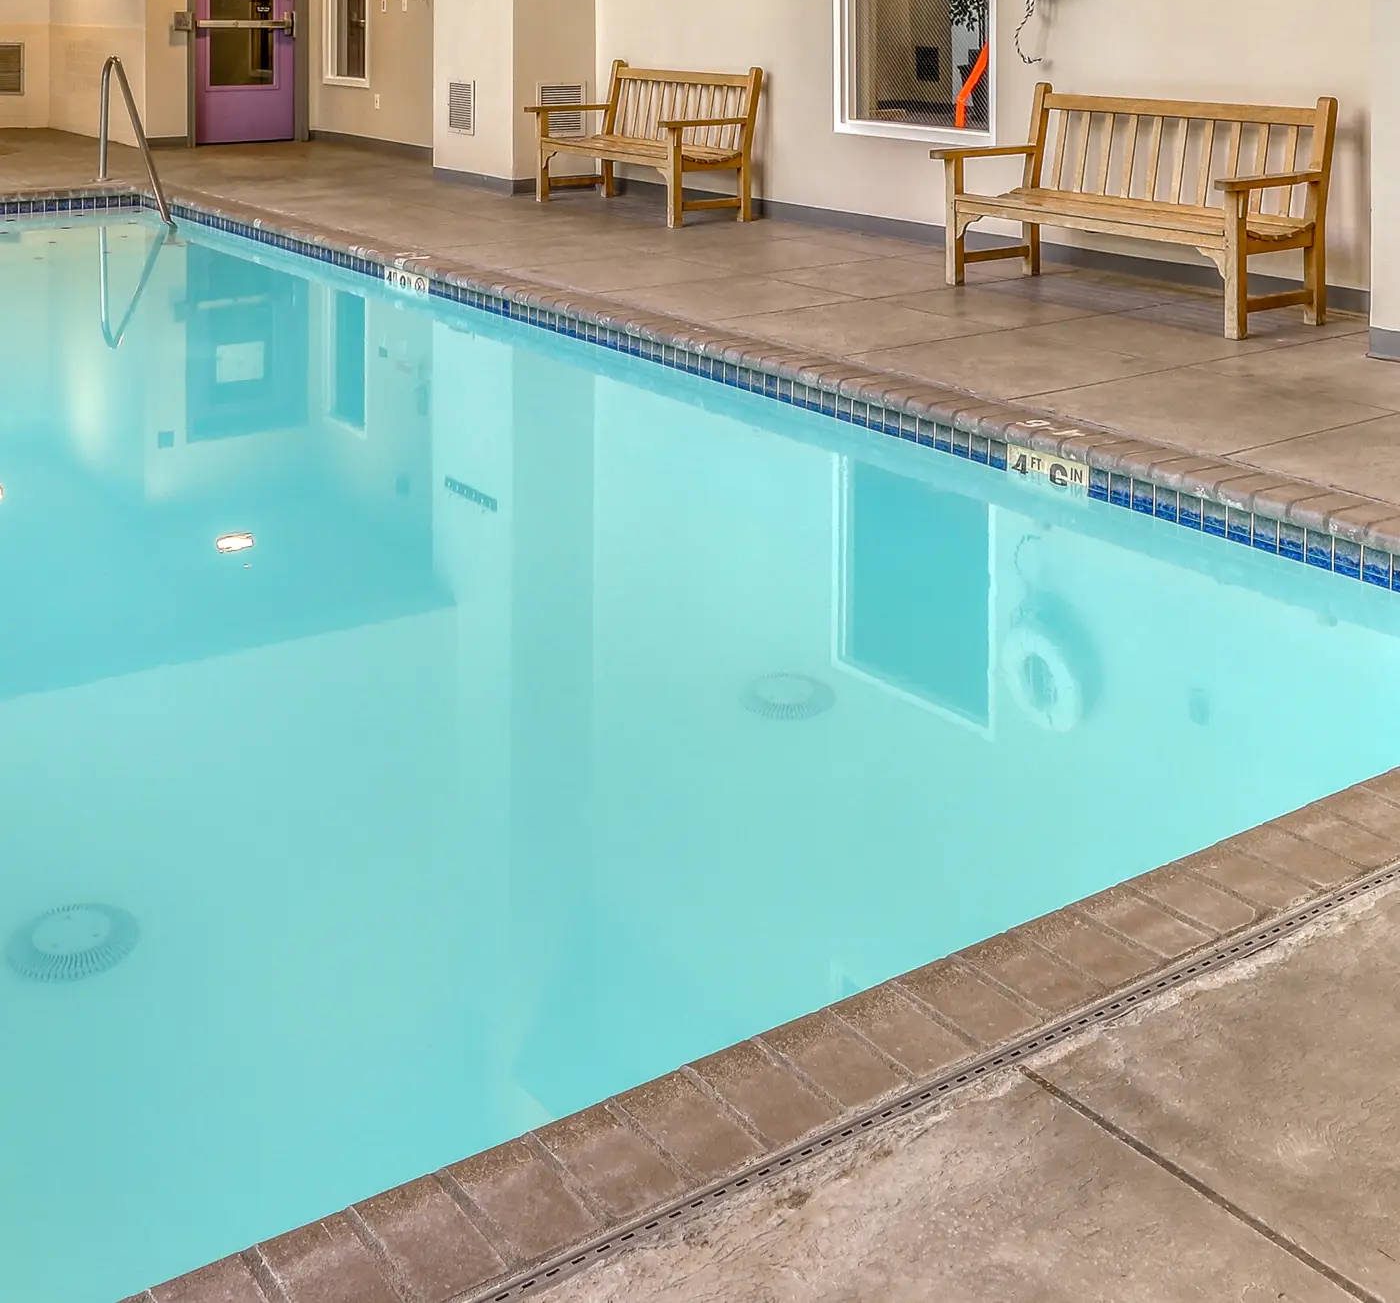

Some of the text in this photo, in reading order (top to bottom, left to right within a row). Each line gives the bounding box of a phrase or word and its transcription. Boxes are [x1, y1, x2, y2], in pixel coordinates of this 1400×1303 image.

[1011, 453, 1029, 475] 4
[1030, 457, 1042, 471] FT
[1070, 467, 1083, 484] IN
